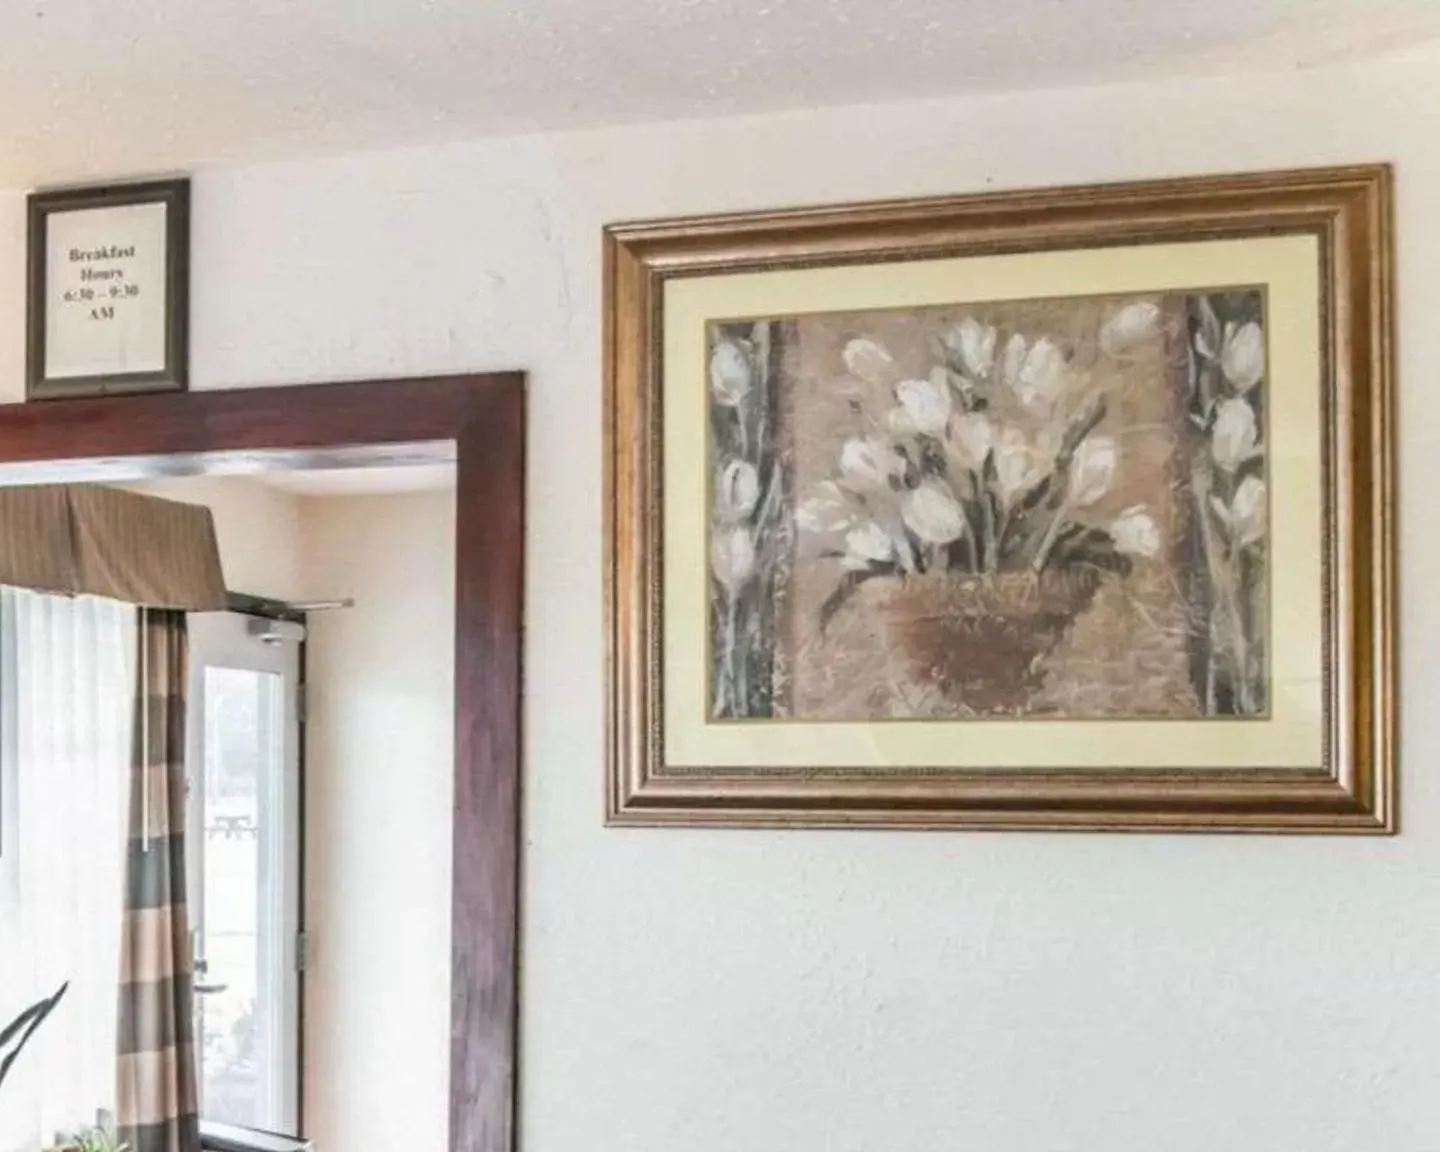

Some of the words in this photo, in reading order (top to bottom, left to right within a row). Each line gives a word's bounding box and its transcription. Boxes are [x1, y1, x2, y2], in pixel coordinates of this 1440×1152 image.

[68, 245, 135, 262] Breakfast
[81, 268, 124, 281] Hours
[64, 288, 94, 301] 6:30
[109, 285, 139, 298] 9:30
[89, 306, 114, 320] AM
